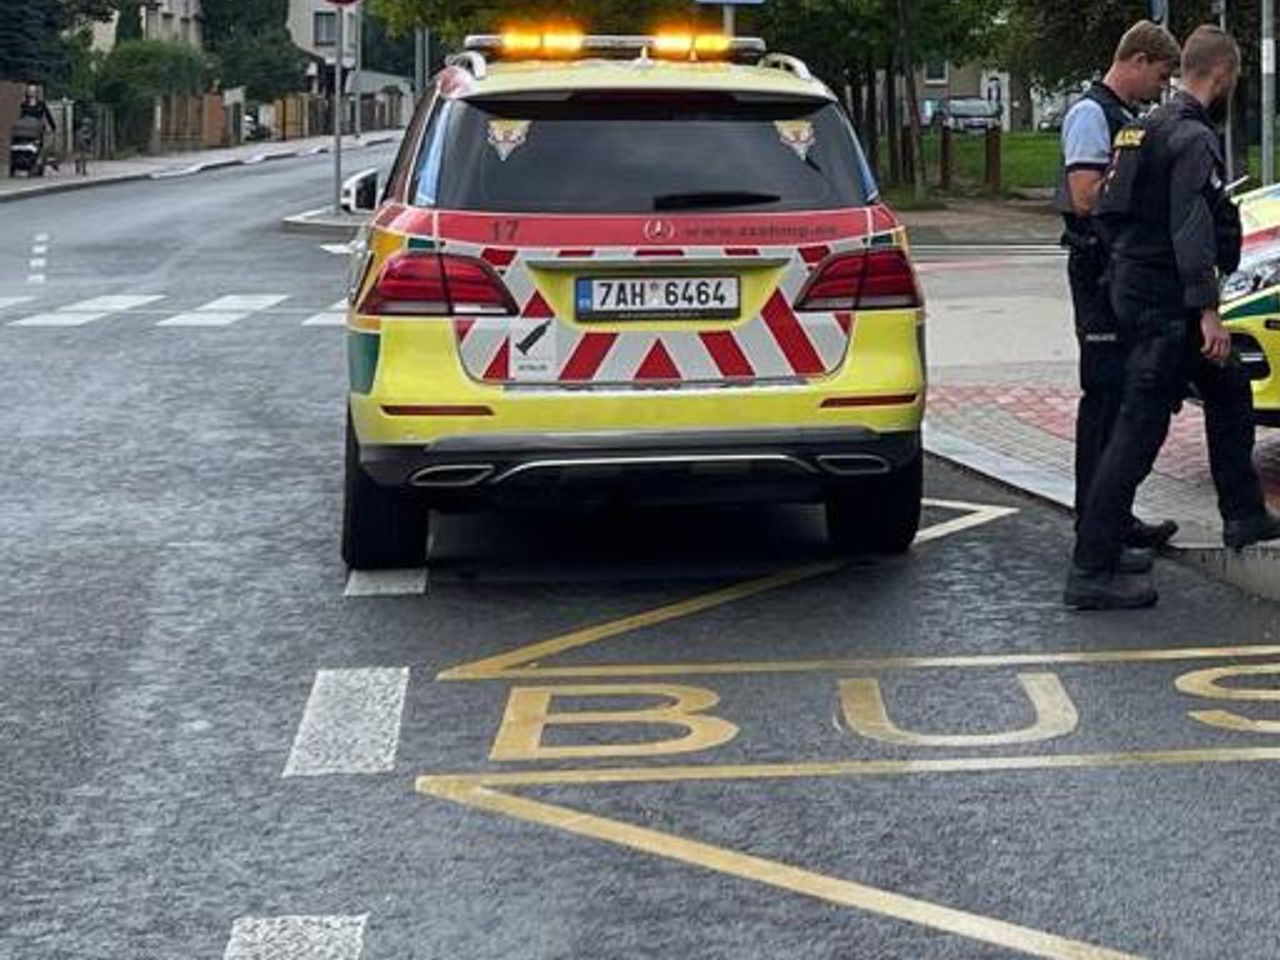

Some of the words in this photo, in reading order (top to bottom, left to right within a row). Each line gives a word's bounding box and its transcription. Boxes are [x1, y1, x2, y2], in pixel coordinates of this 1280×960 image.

[492, 220, 519, 241] 17
[599, 281, 645, 307] 7AH
[664, 281, 726, 307] 6464
